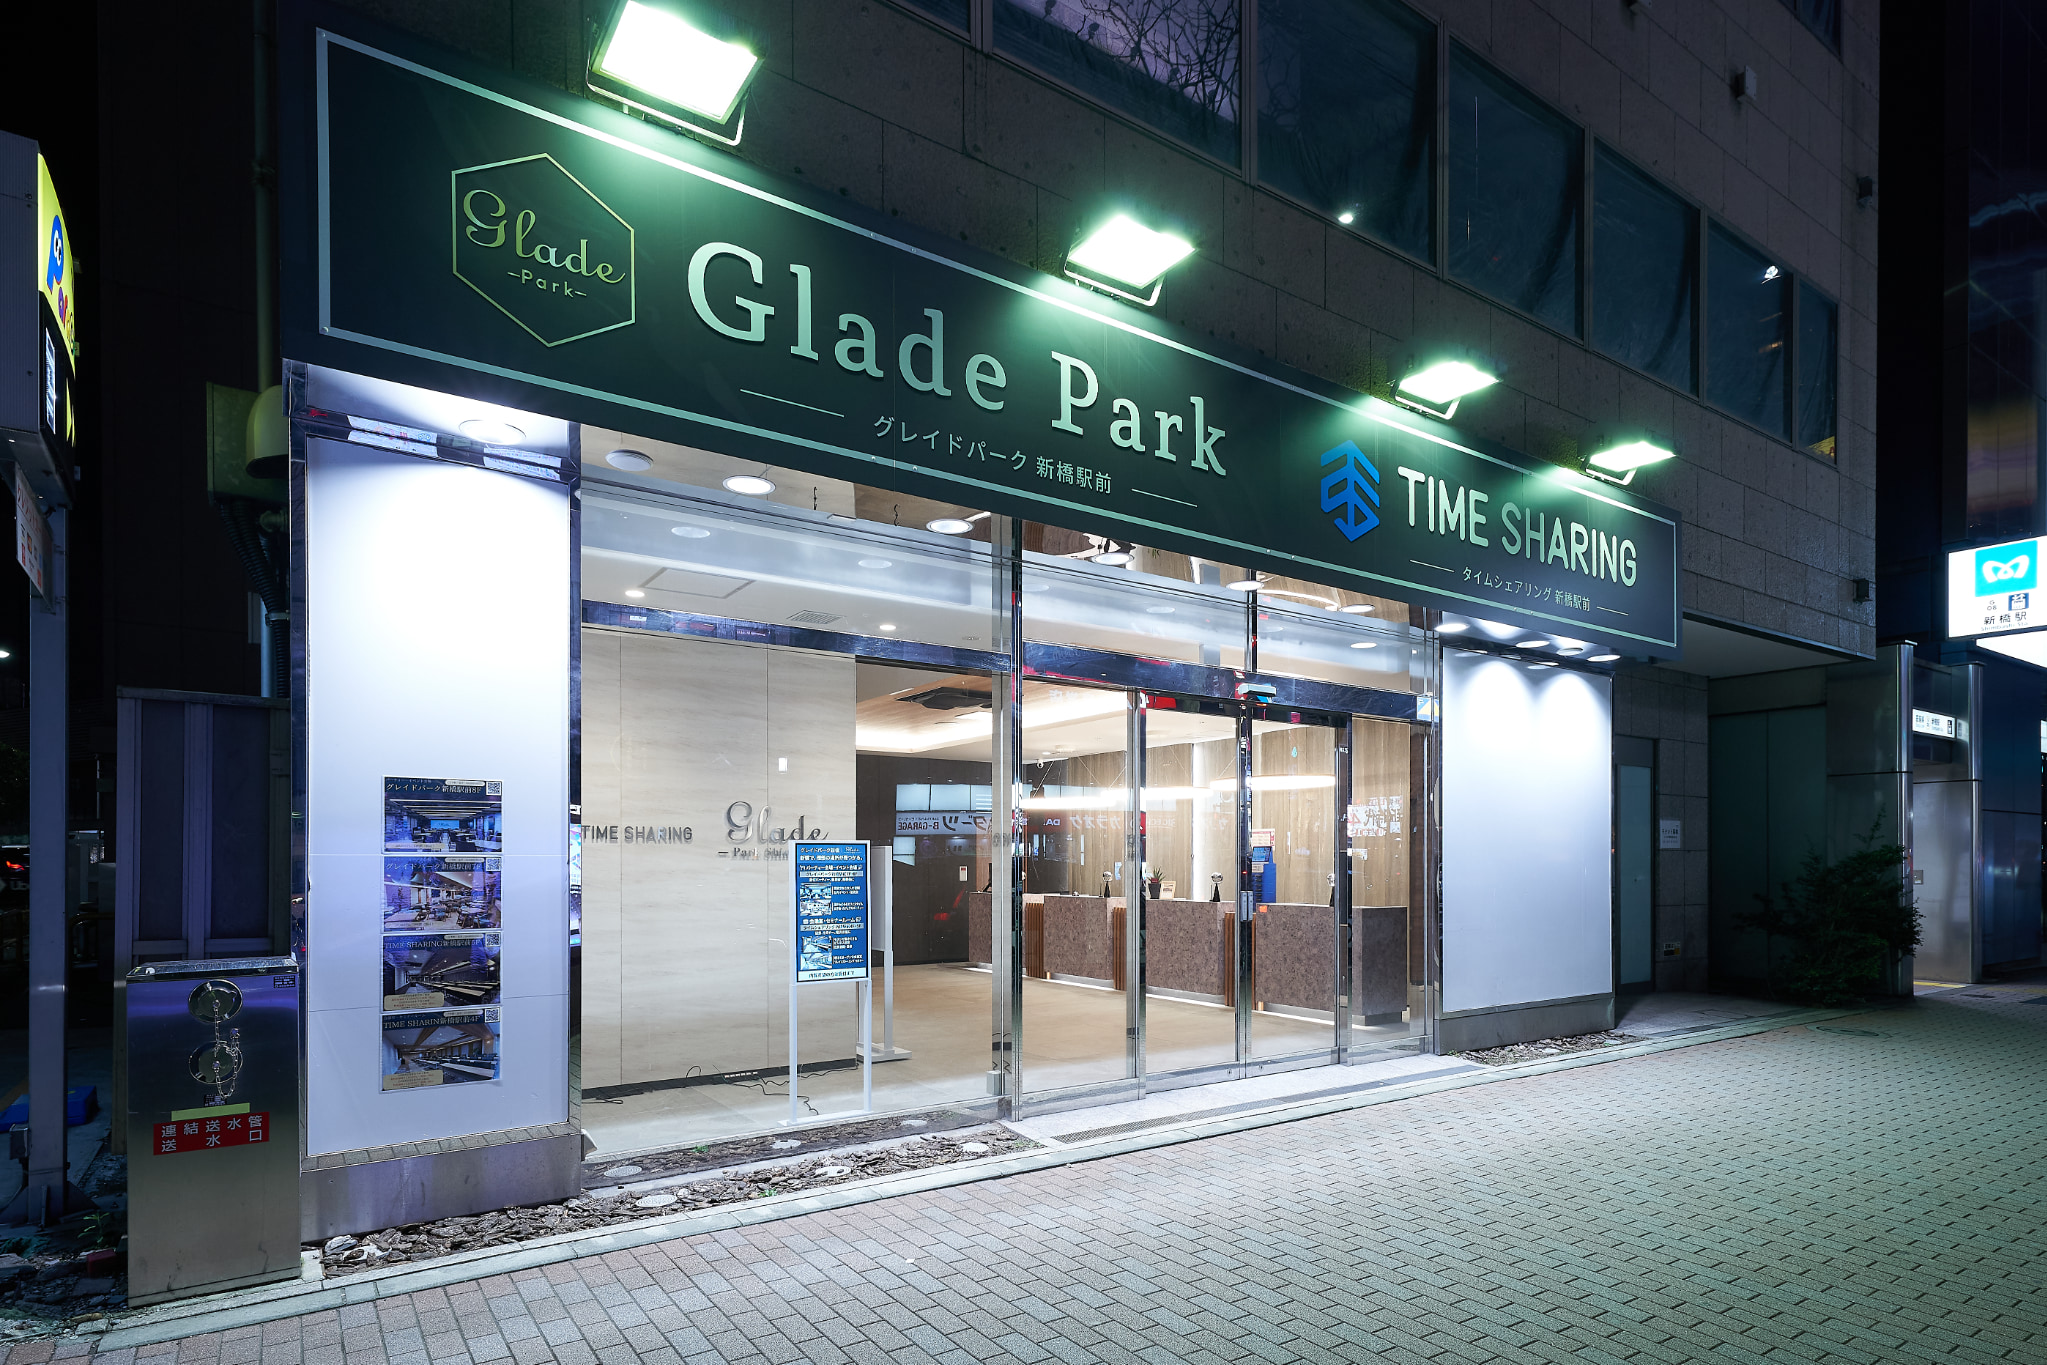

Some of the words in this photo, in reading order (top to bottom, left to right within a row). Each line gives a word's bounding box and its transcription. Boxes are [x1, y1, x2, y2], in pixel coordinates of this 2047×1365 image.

[462, 188, 625, 285] Glade
[687, 241, 1008, 412] Glade
[1050, 350, 1228, 478] Park
[873, 414, 1028, 472] グレイドパーク
[1036, 455, 1112, 495] 新橋駅前
[1397, 465, 1489, 548] TIME
[1501, 501, 1638, 588] SHARING
[1462, 565, 1552, 602] タイムシェアリング
[1554, 589, 1591, 613] 新橋駅前
[1984, 611, 2028, 626] 新橋駅
[583, 825, 618, 841] TIME
[624, 825, 693, 842] SHARING
[726, 800, 829, 843] Glade
[383, 1020, 406, 1029] TIME
[161, 1114, 263, 1138] 連結送水管
[161, 1129, 263, 1153] 送水口
